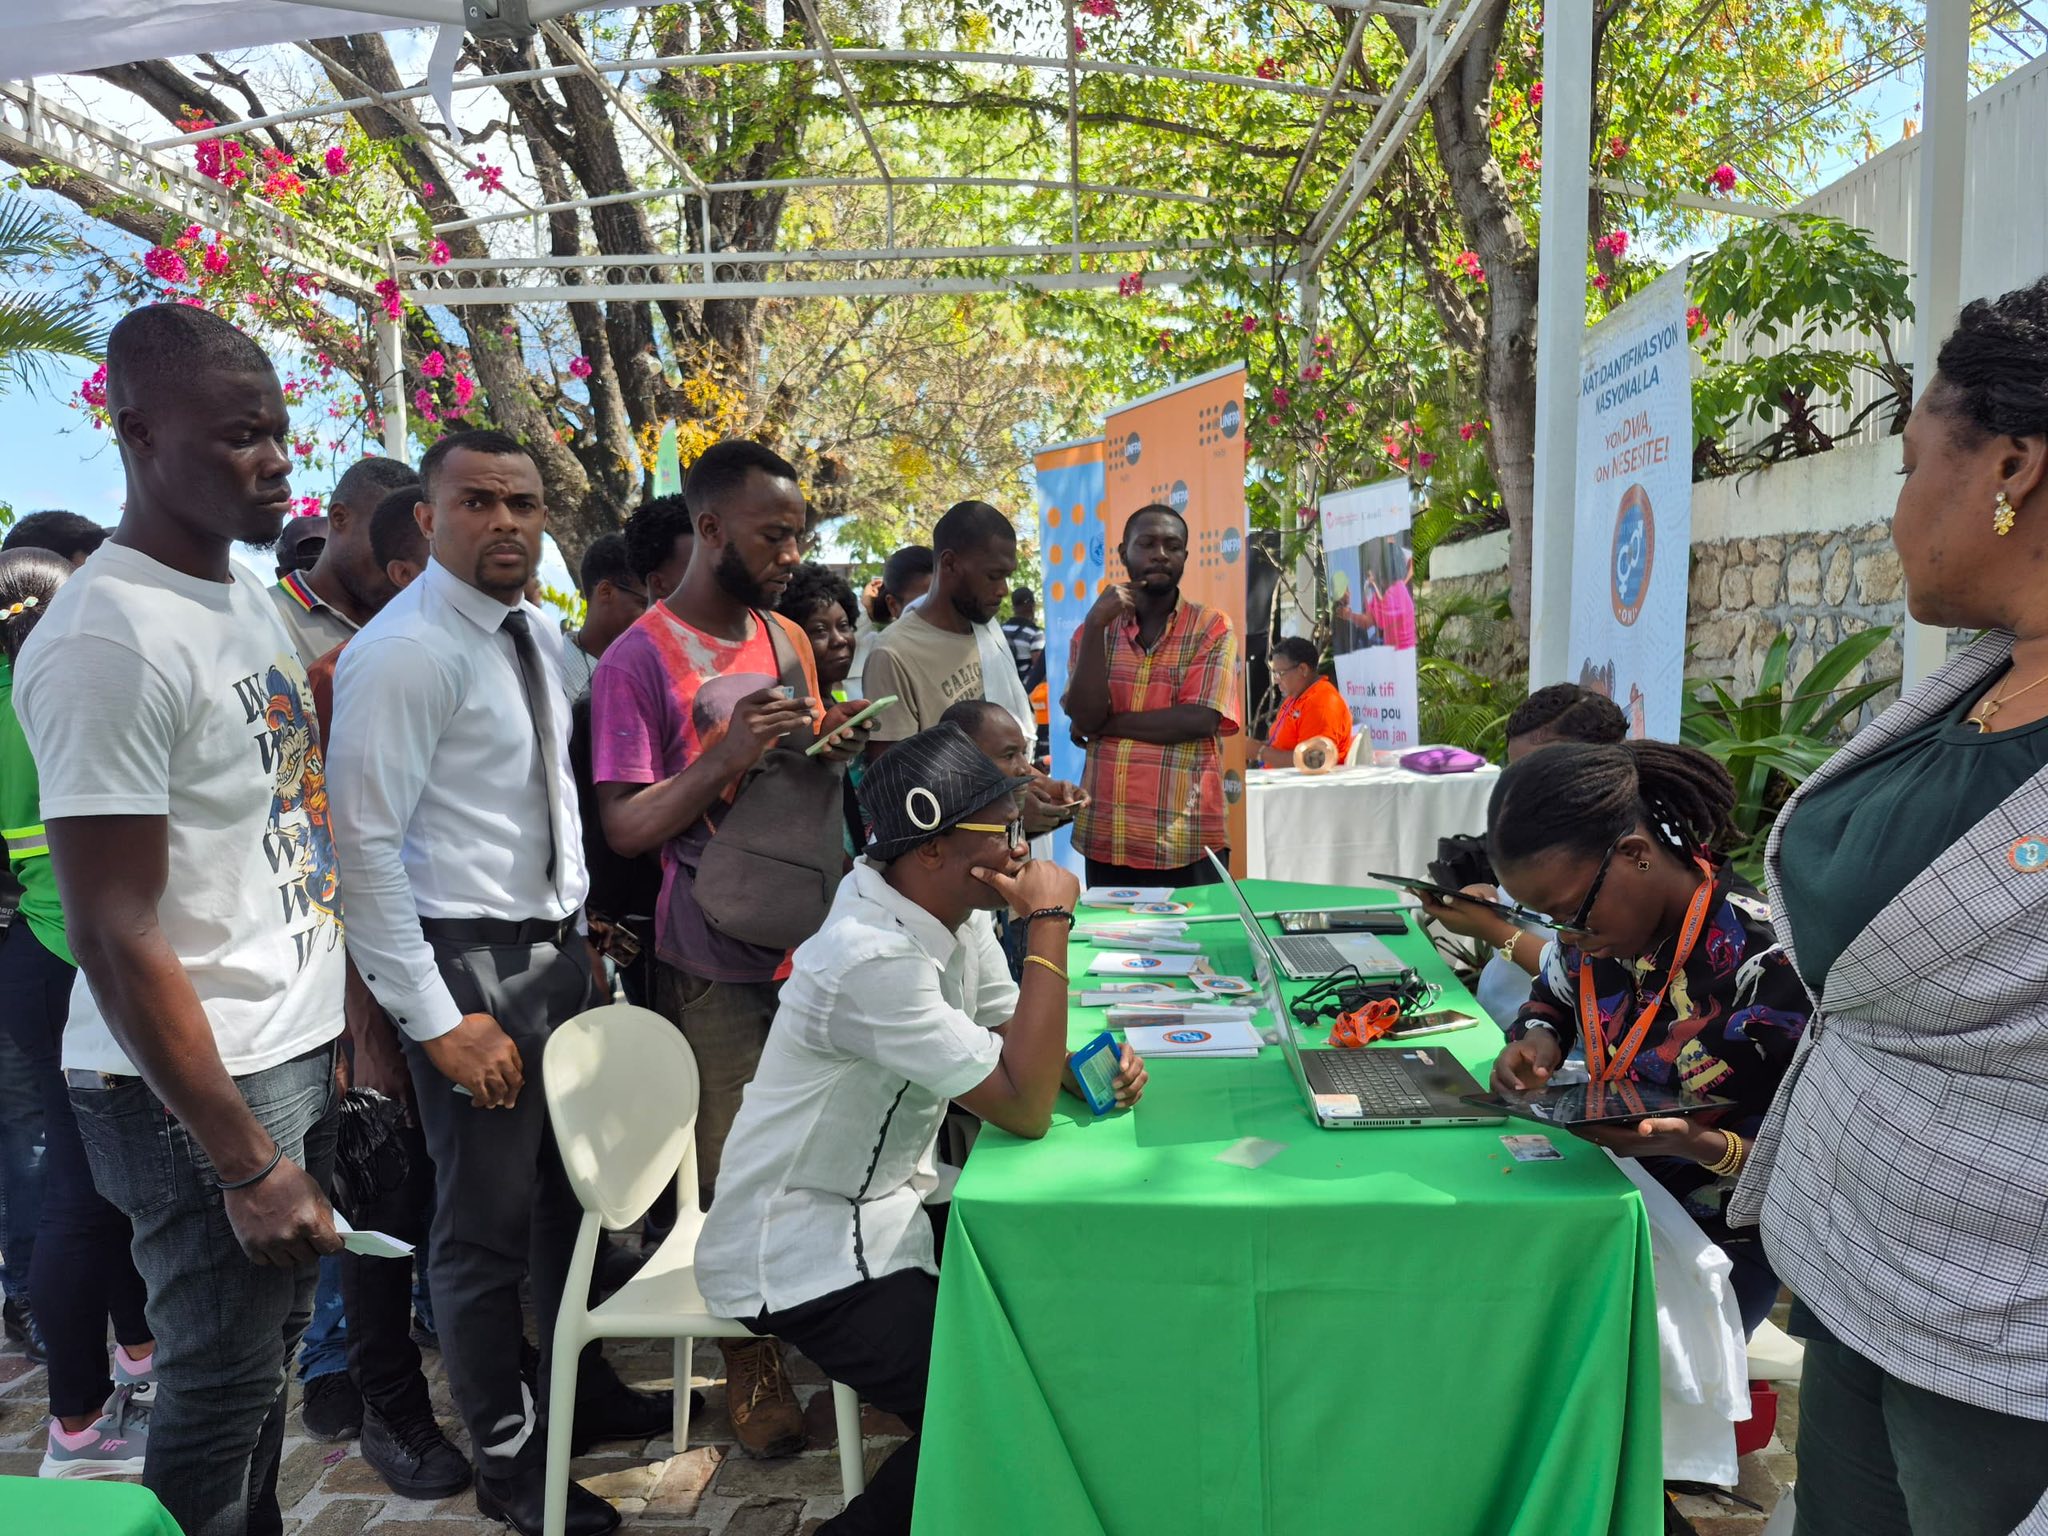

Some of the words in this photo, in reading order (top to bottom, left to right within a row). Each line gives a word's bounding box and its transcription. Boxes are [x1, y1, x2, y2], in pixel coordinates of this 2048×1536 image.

[1582, 371, 1599, 397] KAT
[1220, 410, 1240, 428] UNFPA
[1605, 431, 1622, 451] YON
[1623, 410, 1652, 443] DWA,
[1125, 440, 1141, 457] UNFPA
[1612, 435, 1669, 479] NESESITE!
[1169, 490, 1188, 505] UNFPA
[1220, 538, 1241, 553] UNFPA
[1367, 682, 1376, 697] ak
[1379, 682, 1395, 697] tifi
[1381, 708, 1401, 723] pou
[1370, 726, 1389, 740] bon
[1392, 726, 1407, 745] jan
[1684, 914, 1700, 948] NATIONAL
[1589, 1020, 1599, 1051] NATIONAL
